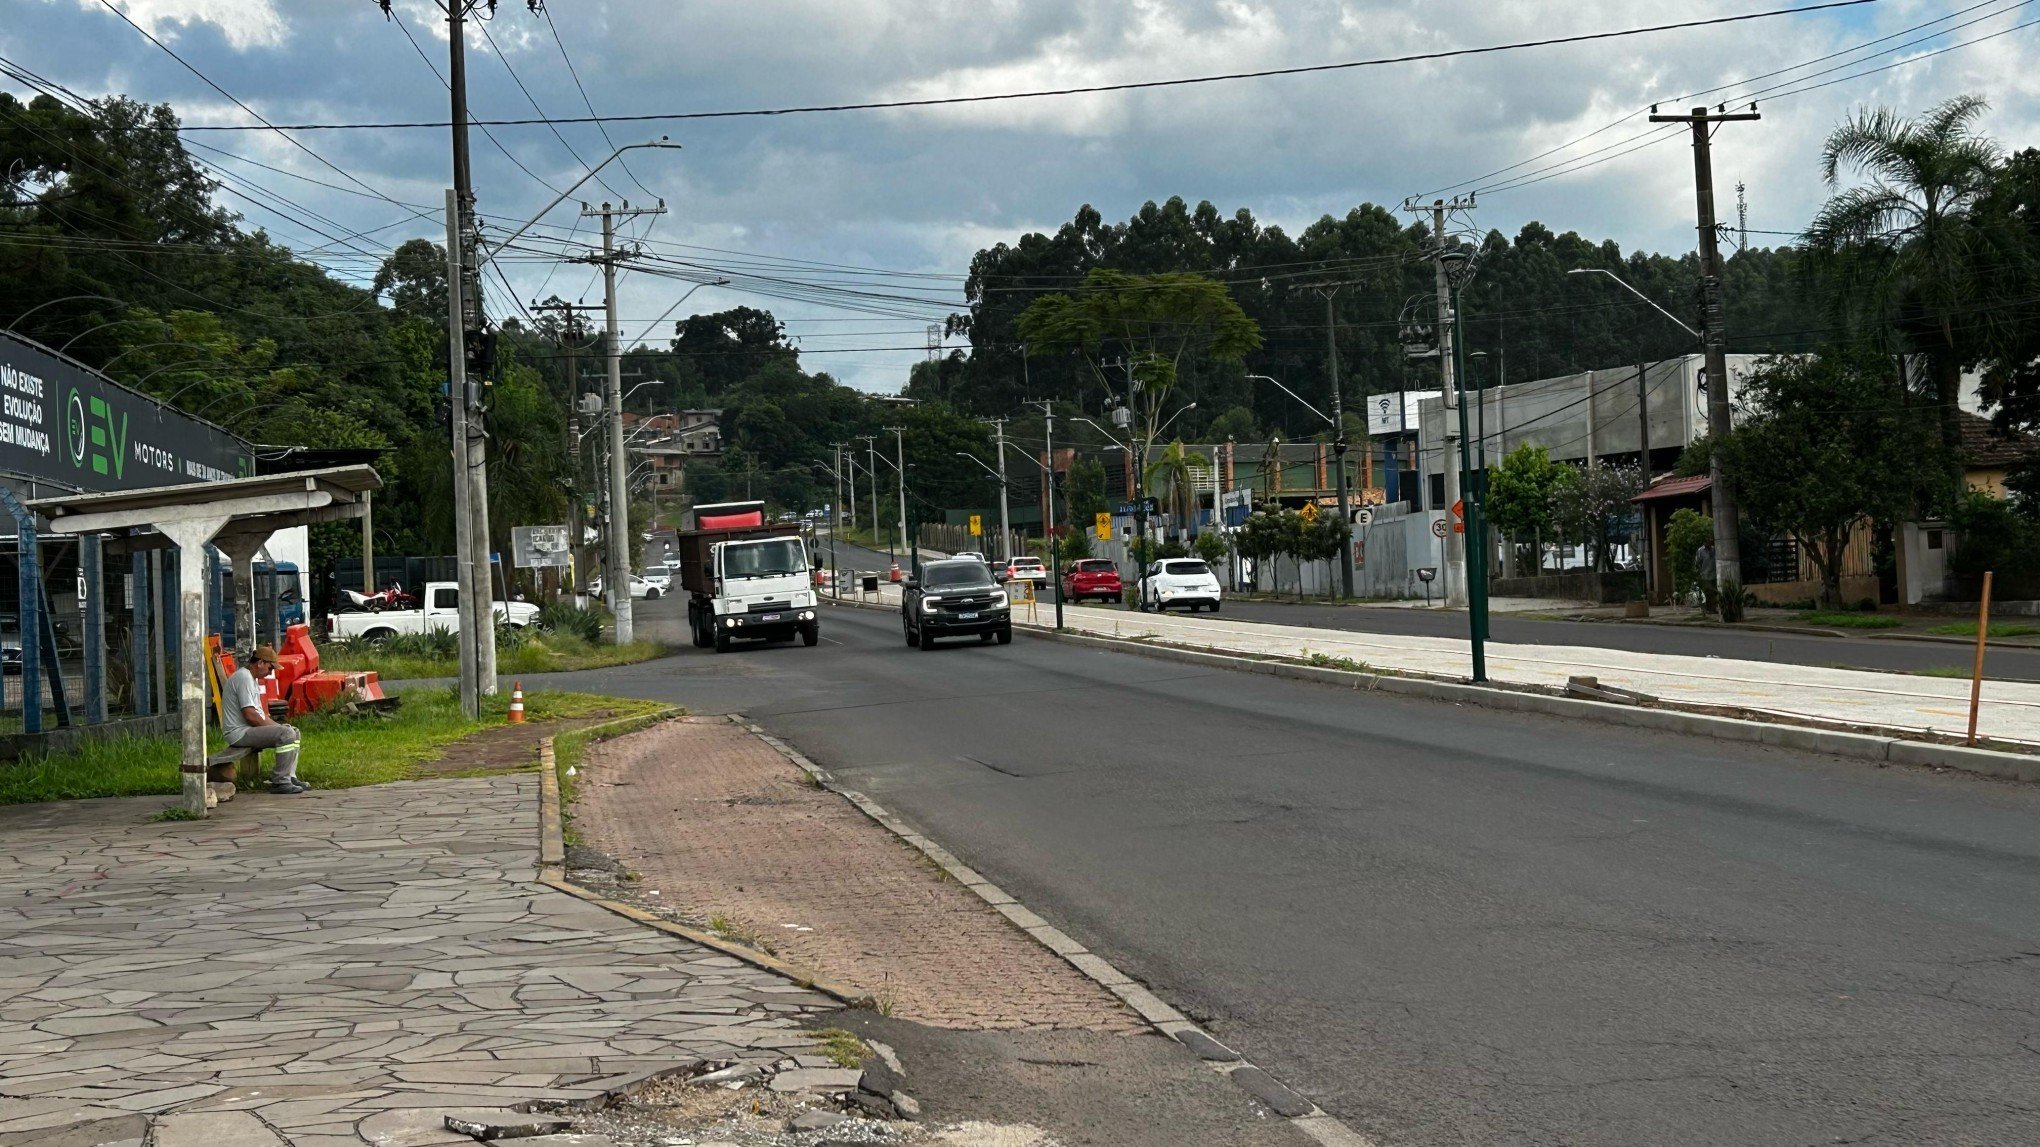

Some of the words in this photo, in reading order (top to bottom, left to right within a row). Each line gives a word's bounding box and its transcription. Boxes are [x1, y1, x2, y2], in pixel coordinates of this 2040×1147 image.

[1, 363, 17, 389] NÃO
[19, 371, 43, 398] EXISTE
[4, 394, 42, 426] EVOLUÇÃO
[15, 425, 50, 456] MUDANÇA
[90, 395, 128, 480] EV
[134, 440, 174, 472] MOTORS
[1361, 513, 1367, 523] E
